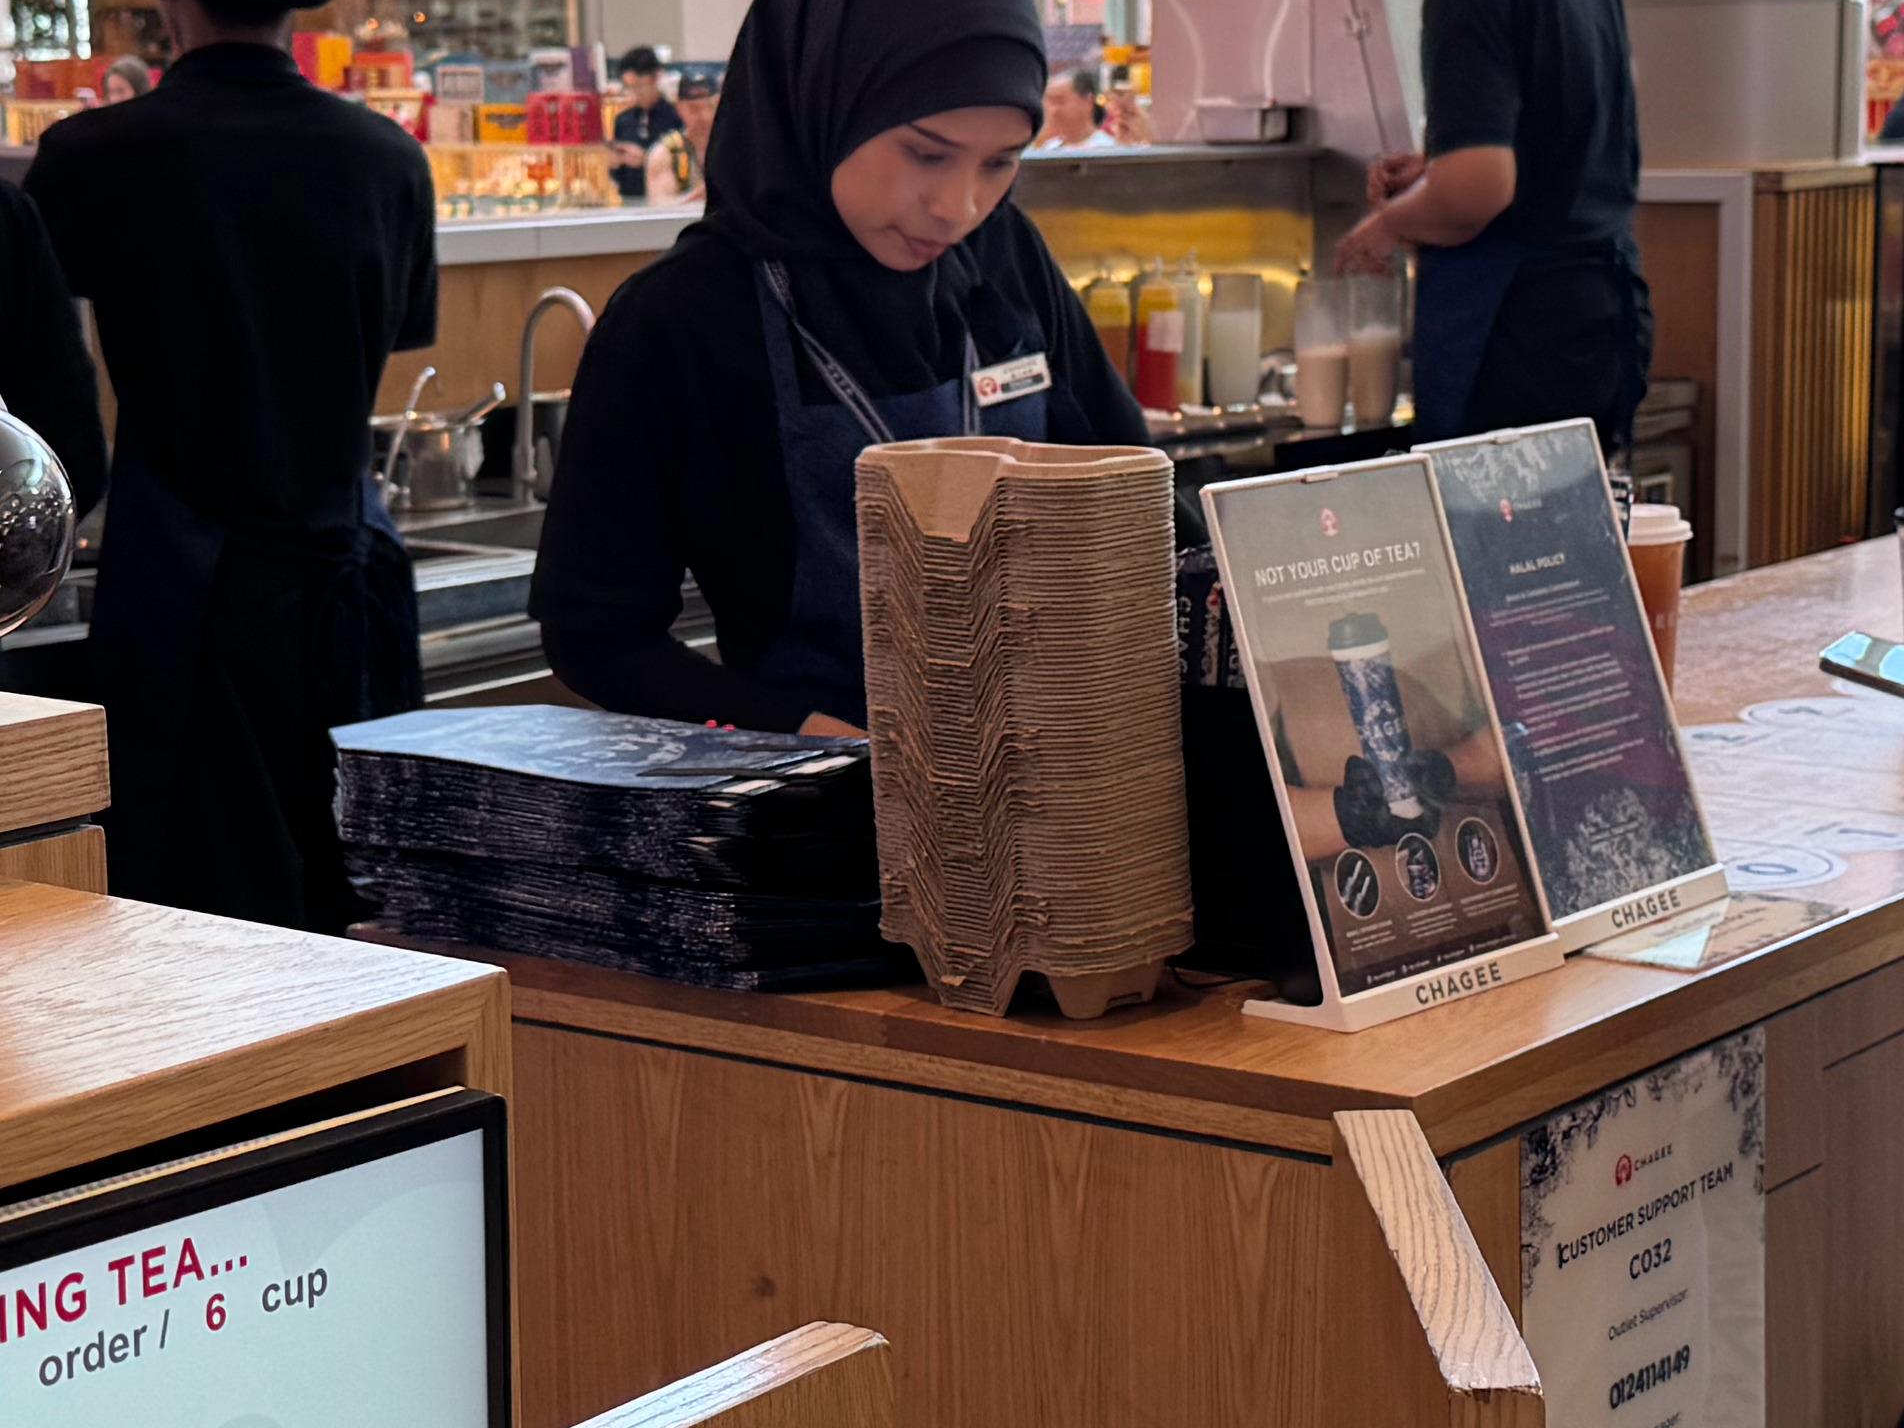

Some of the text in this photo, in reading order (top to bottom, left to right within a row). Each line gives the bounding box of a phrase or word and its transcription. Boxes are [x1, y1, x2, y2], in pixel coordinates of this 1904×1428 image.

[1254, 541, 1420, 587] NOT YOUR CUP OF TEA?
[1610, 888, 1682, 928] CHAGEE
[1415, 962, 1503, 1005] CHAGEE
[1557, 1161, 1734, 1269] CUSTOMER SUPPORT TEAM
[205, 1295, 226, 1333] 6
[260, 1265, 329, 1315] cup
